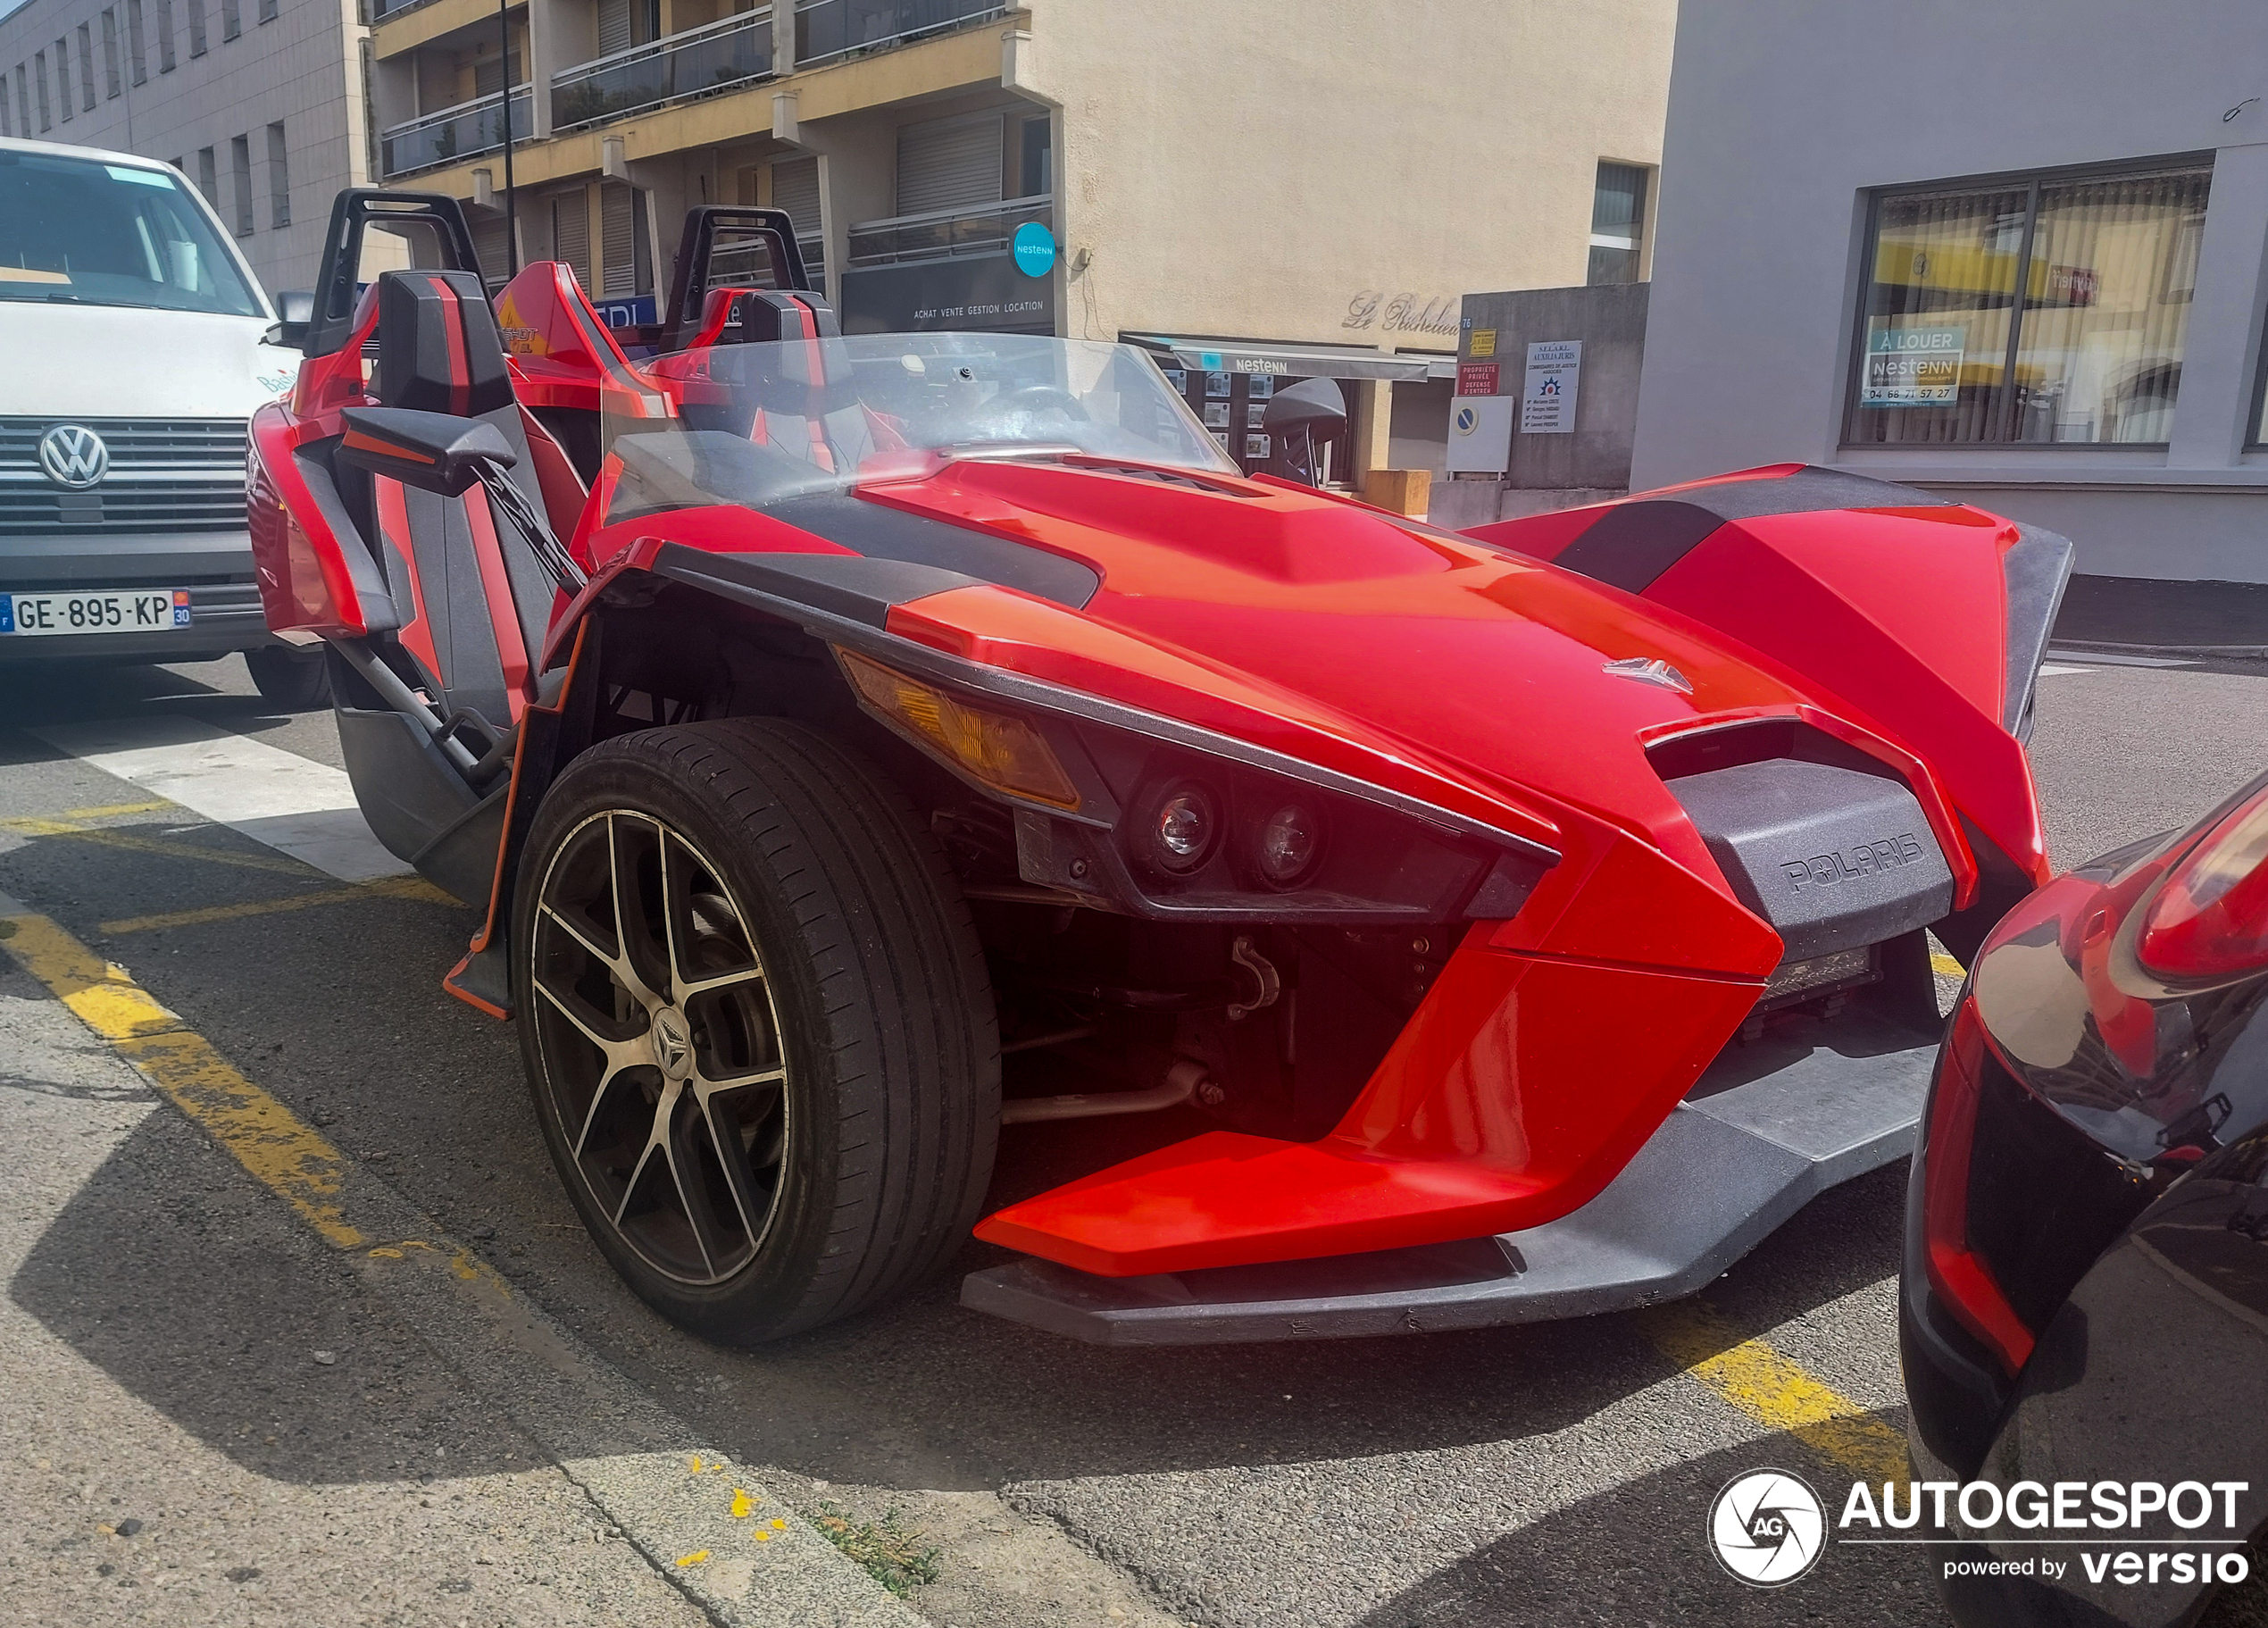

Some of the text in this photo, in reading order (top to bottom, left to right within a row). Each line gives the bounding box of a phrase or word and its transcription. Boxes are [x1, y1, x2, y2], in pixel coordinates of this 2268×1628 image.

[913, 300, 1043, 319] ACHAT VENTE GESTION LOCATION
[1341, 290, 1383, 330] Le
[1462, 318, 1472, 329] 76
[1880, 331, 1953, 350] À LOUER
[1870, 390, 1882, 399] 04
[1905, 389, 1915, 398] 71
[1920, 388, 1933, 398] 57
[1937, 388, 1950, 398] 27
[2, 616, 9, 626] F
[18, 596, 168, 629] GE-895-KP
[175, 609, 189, 622] 30
[1780, 832, 1924, 893] POLARIS
